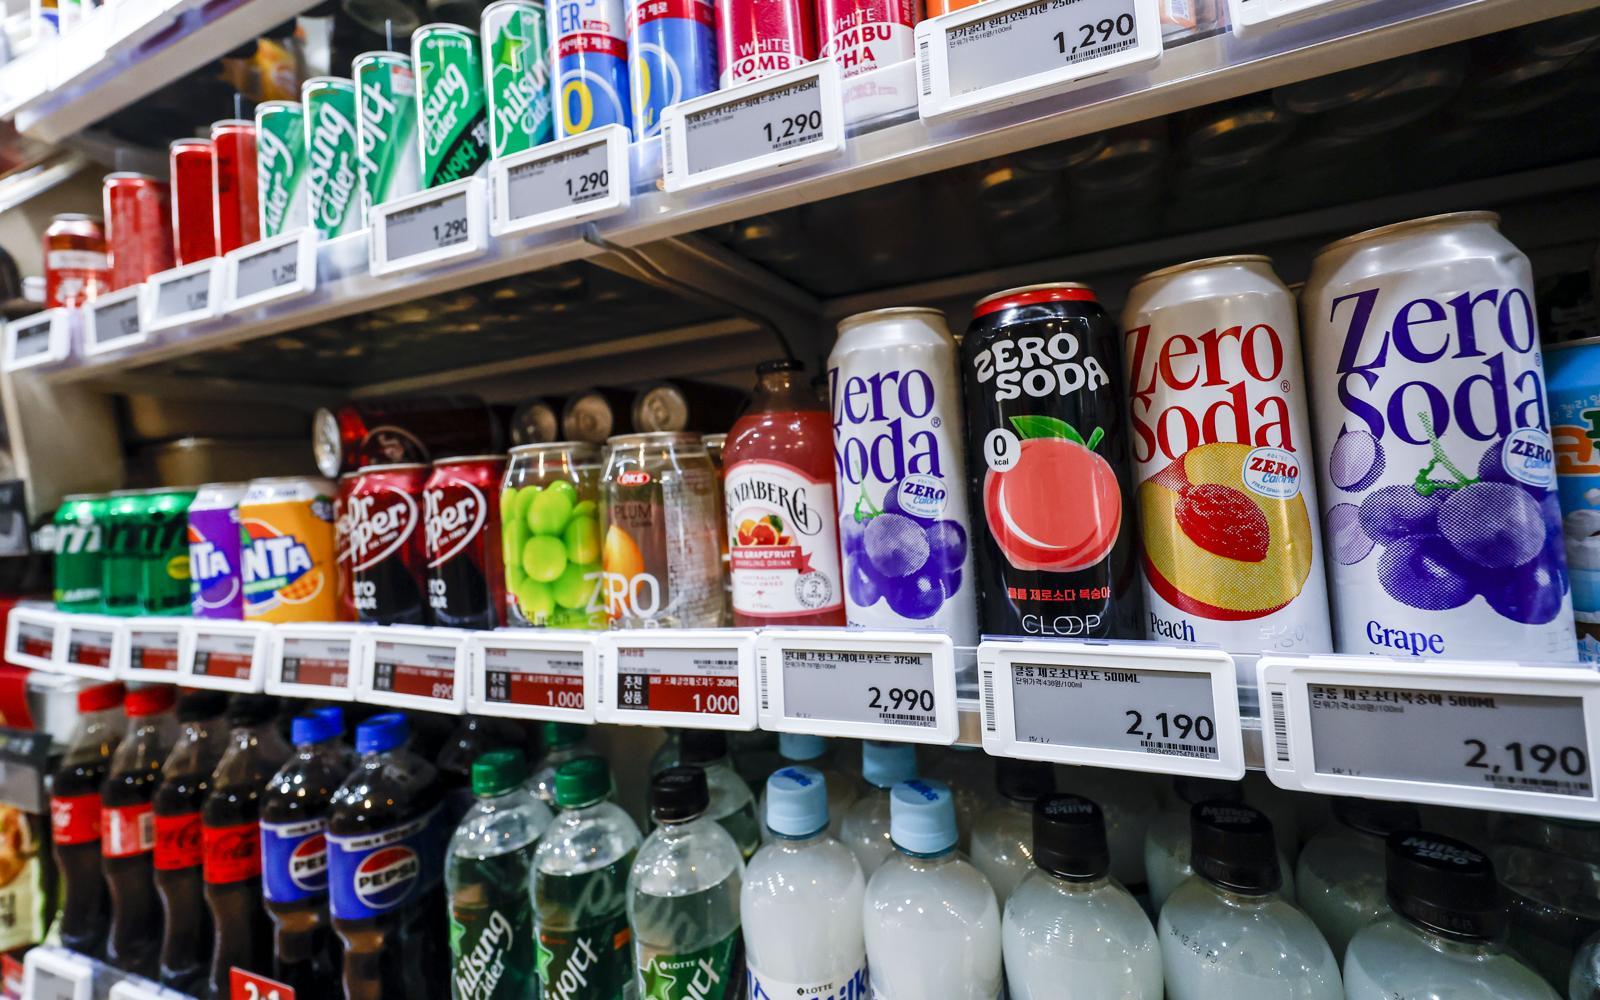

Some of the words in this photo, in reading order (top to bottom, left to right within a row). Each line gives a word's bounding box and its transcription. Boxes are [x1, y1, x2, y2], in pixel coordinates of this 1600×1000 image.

[740, 38, 790, 55] WHITE
[1053, 13, 1135, 54] 1,290
[732, 54, 803, 81] KOMB
[562, 80, 593, 135] 0
[763, 110, 822, 143] 1,290
[565, 170, 609, 198] 1,290
[433, 217, 468, 242] 1,290
[1330, 288, 1535, 374] Zero
[973, 332, 1079, 384] ZERO
[1125, 323, 1284, 397] Zero
[995, 356, 1110, 401] SODA
[1337, 352, 1549, 445] Soda
[1130, 380, 1297, 464] Soda
[993, 434, 1007, 457] 0
[1510, 438, 1552, 463] ZERO
[993, 457, 1009, 466] kcal
[1250, 456, 1298, 479] ZERO
[903, 482, 946, 501] ZERO
[1007, 587, 1027, 600] 클룹
[1030, 588, 1076, 601] 제로소다
[1079, 586, 1111, 600] 복숭아
[1150, 612, 1196, 642] Peach
[1366, 620, 1445, 656] Grape
[894, 655, 923, 666] 375ML
[1037, 668, 1101, 682] 제로소다포도
[1104, 671, 1141, 684] 500ML
[547, 690, 584, 708] 1,000
[693, 694, 738, 713] 1,000
[868, 686, 935, 713] 2,990
[1449, 695, 1498, 710] 500ML
[1125, 710, 1214, 742] 2,190
[1463, 738, 1587, 777] 2,190
[1415, 849, 1469, 865] zero
[359, 859, 417, 889] PEPSI
[668, 959, 696, 970] LOTTE
[806, 982, 834, 994] LOTTE
